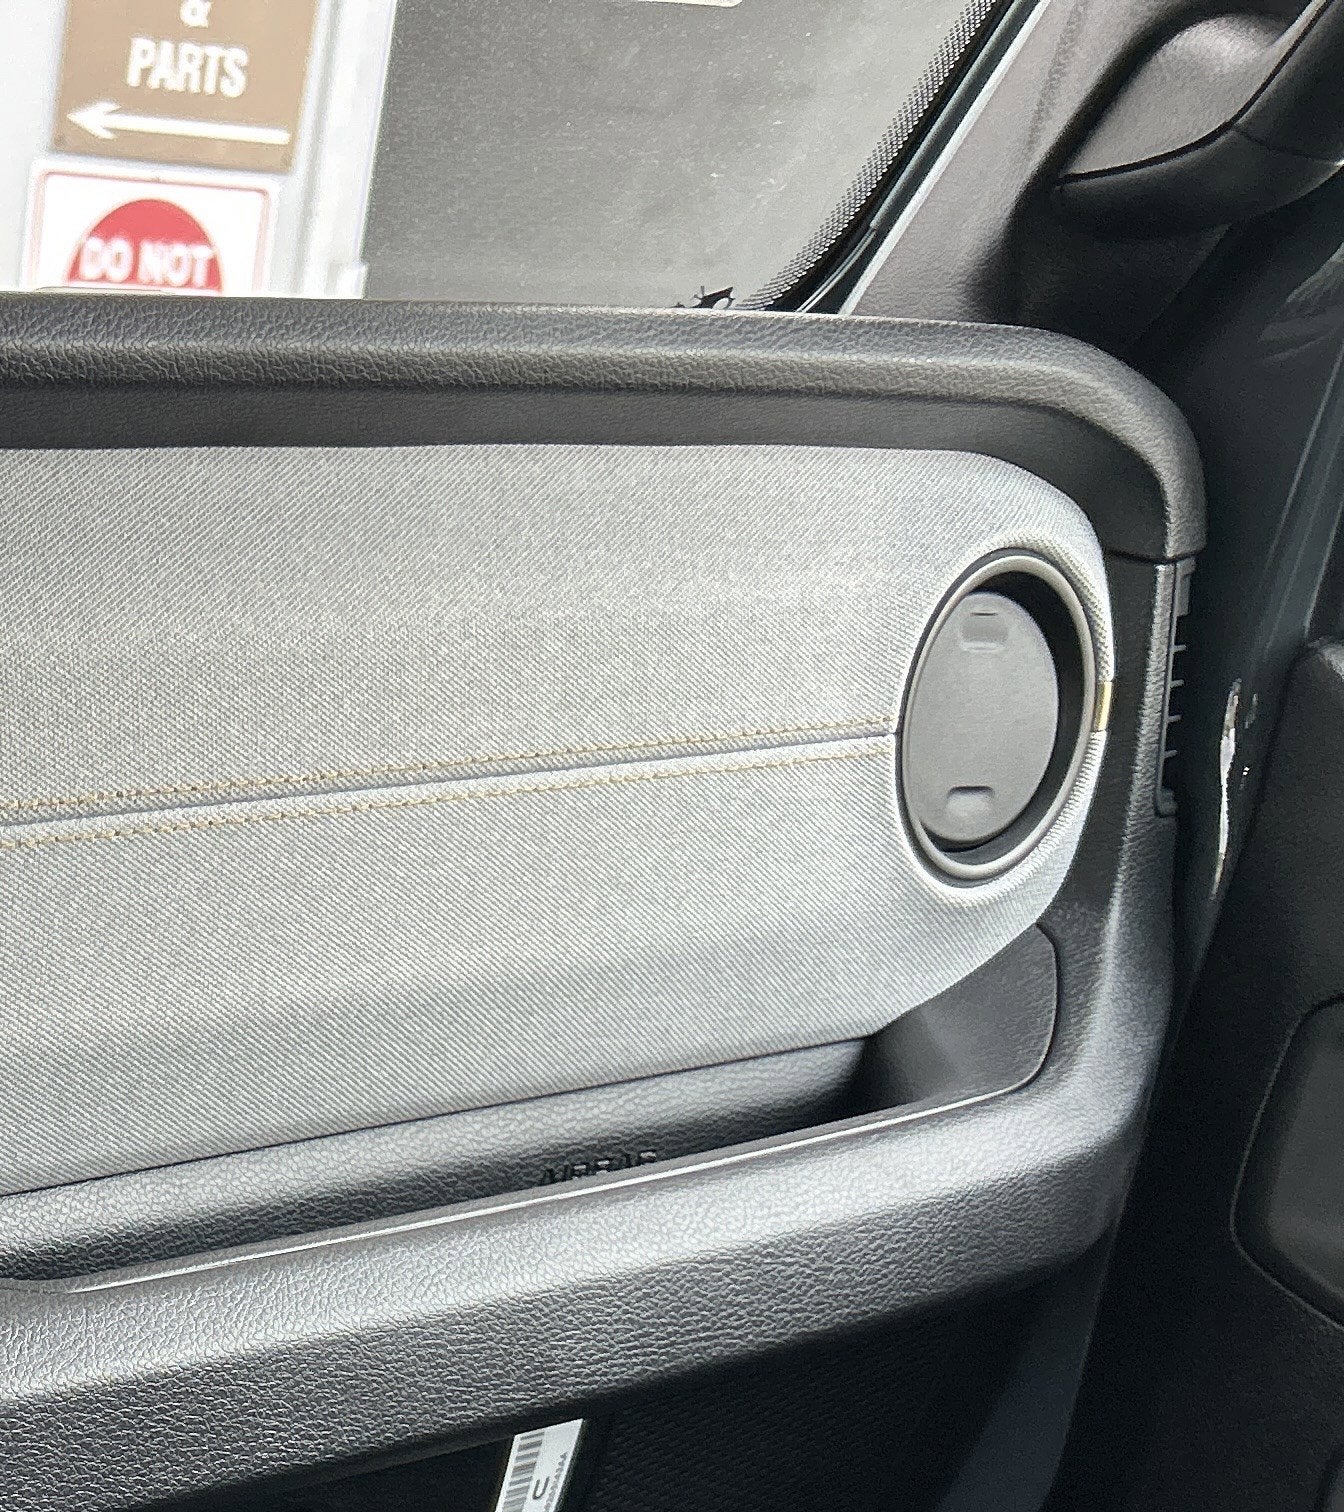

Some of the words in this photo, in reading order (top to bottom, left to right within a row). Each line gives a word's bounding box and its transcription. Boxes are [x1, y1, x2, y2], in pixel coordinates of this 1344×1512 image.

[125, 37, 250, 98] PARTS
[78, 235, 133, 284] DO
[137, 239, 215, 290] NOT
